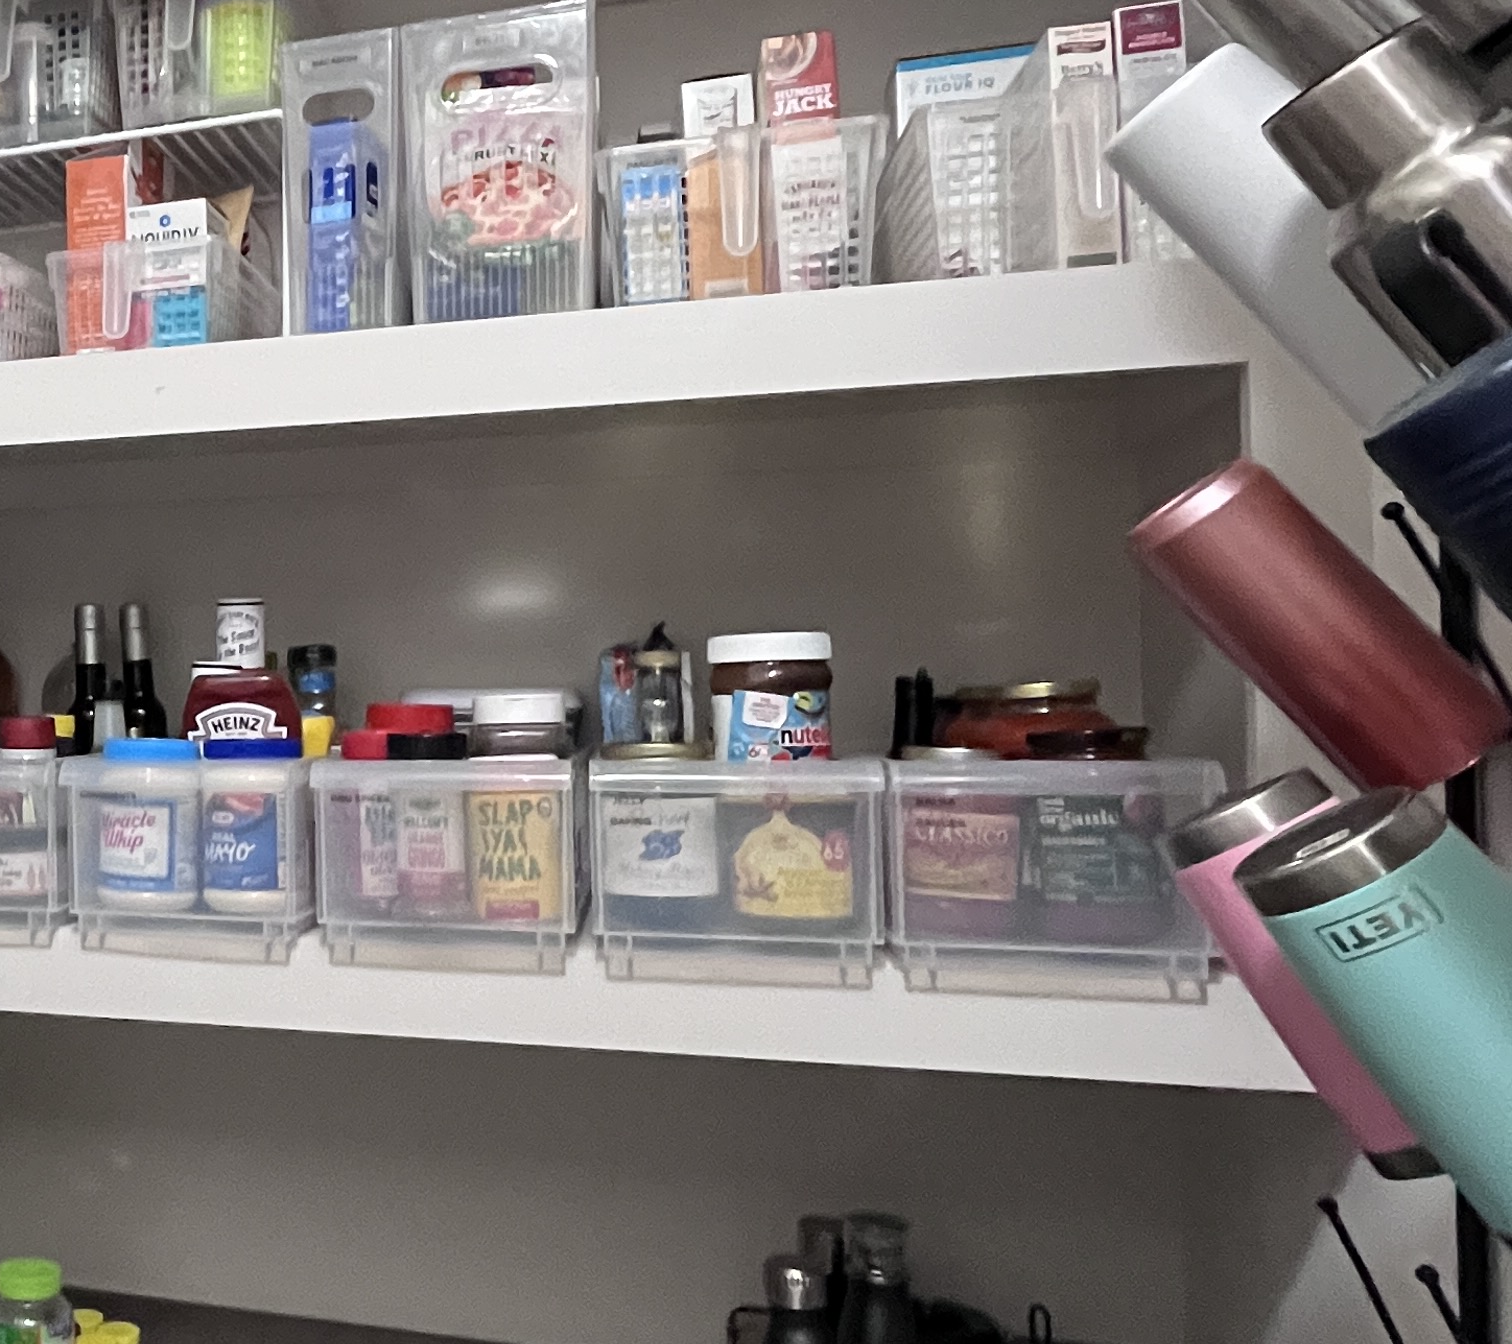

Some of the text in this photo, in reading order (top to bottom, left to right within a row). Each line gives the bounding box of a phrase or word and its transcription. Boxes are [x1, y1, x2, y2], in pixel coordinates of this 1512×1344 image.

[774, 82, 832, 101] HUNGRY
[772, 93, 837, 117] JACK
[211, 716, 261, 734] HEINZ
[479, 799, 533, 827] SLAP
[104, 829, 144, 853] Whip
[479, 856, 542, 882] MAMA
[1328, 901, 1426, 954] YETI
